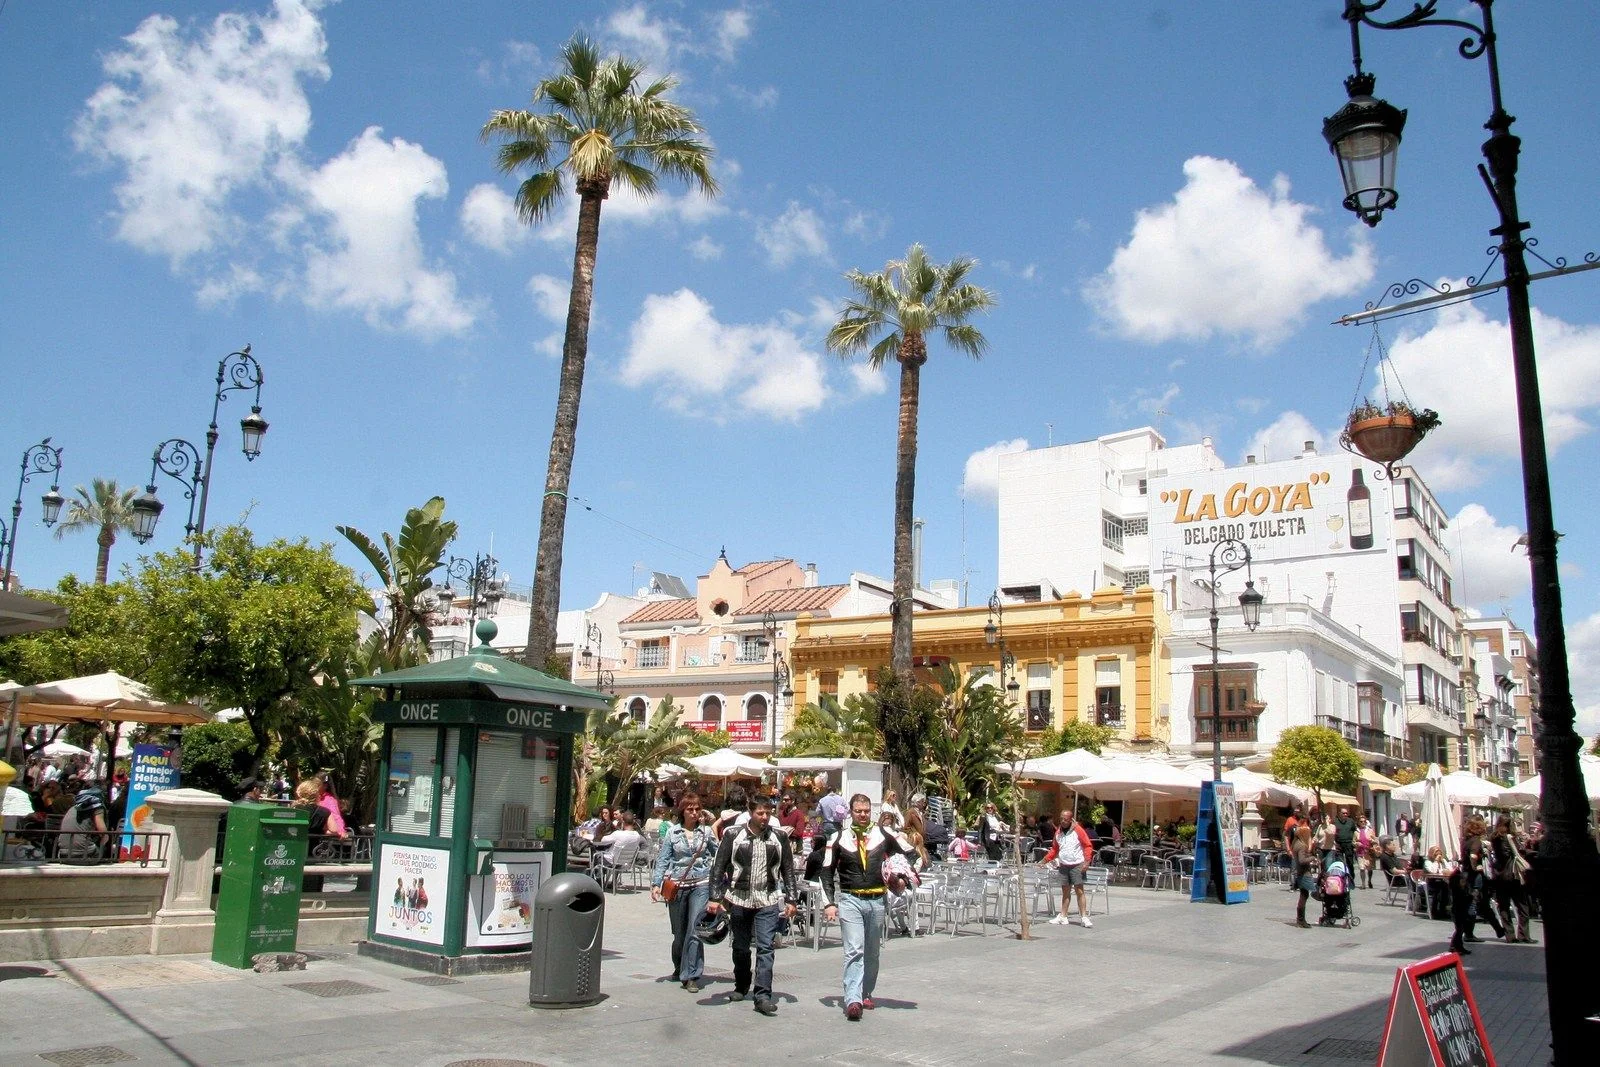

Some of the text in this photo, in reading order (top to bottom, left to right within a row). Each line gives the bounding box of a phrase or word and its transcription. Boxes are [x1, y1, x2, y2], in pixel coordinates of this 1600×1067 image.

[1184, 516, 1307, 546] DELGADO ZULETA
[400, 703, 439, 721] ONCE
[506, 707, 553, 729] ONCE
[135, 765, 174, 775] el mejor
[134, 773, 171, 783] Helado
[133, 782, 147, 791] de
[393, 852, 411, 860] PIENSA
[411, 861, 438, 870] PODEMOS
[404, 867, 423, 875] HACER
[389, 906, 433, 924] JUNTOS
